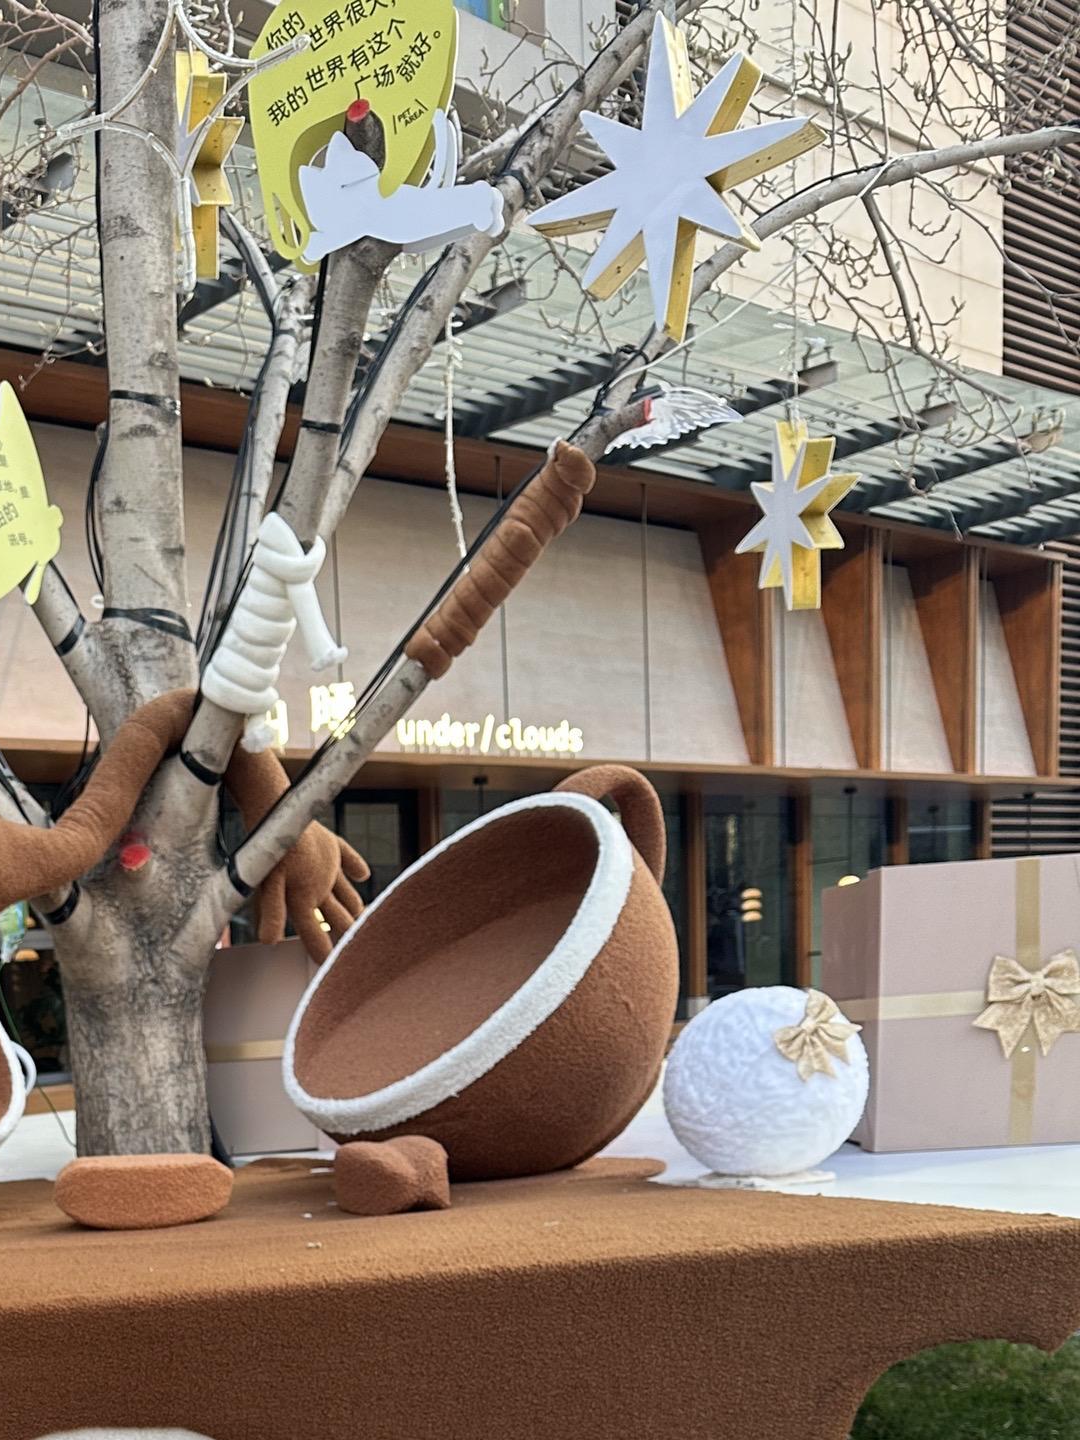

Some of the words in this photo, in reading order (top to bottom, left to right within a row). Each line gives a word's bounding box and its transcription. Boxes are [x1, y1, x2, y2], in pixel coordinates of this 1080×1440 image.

[267, 18, 406, 127] 我的世界有这个
[397, 107, 411, 122] PET
[404, 109, 424, 127] AREA
